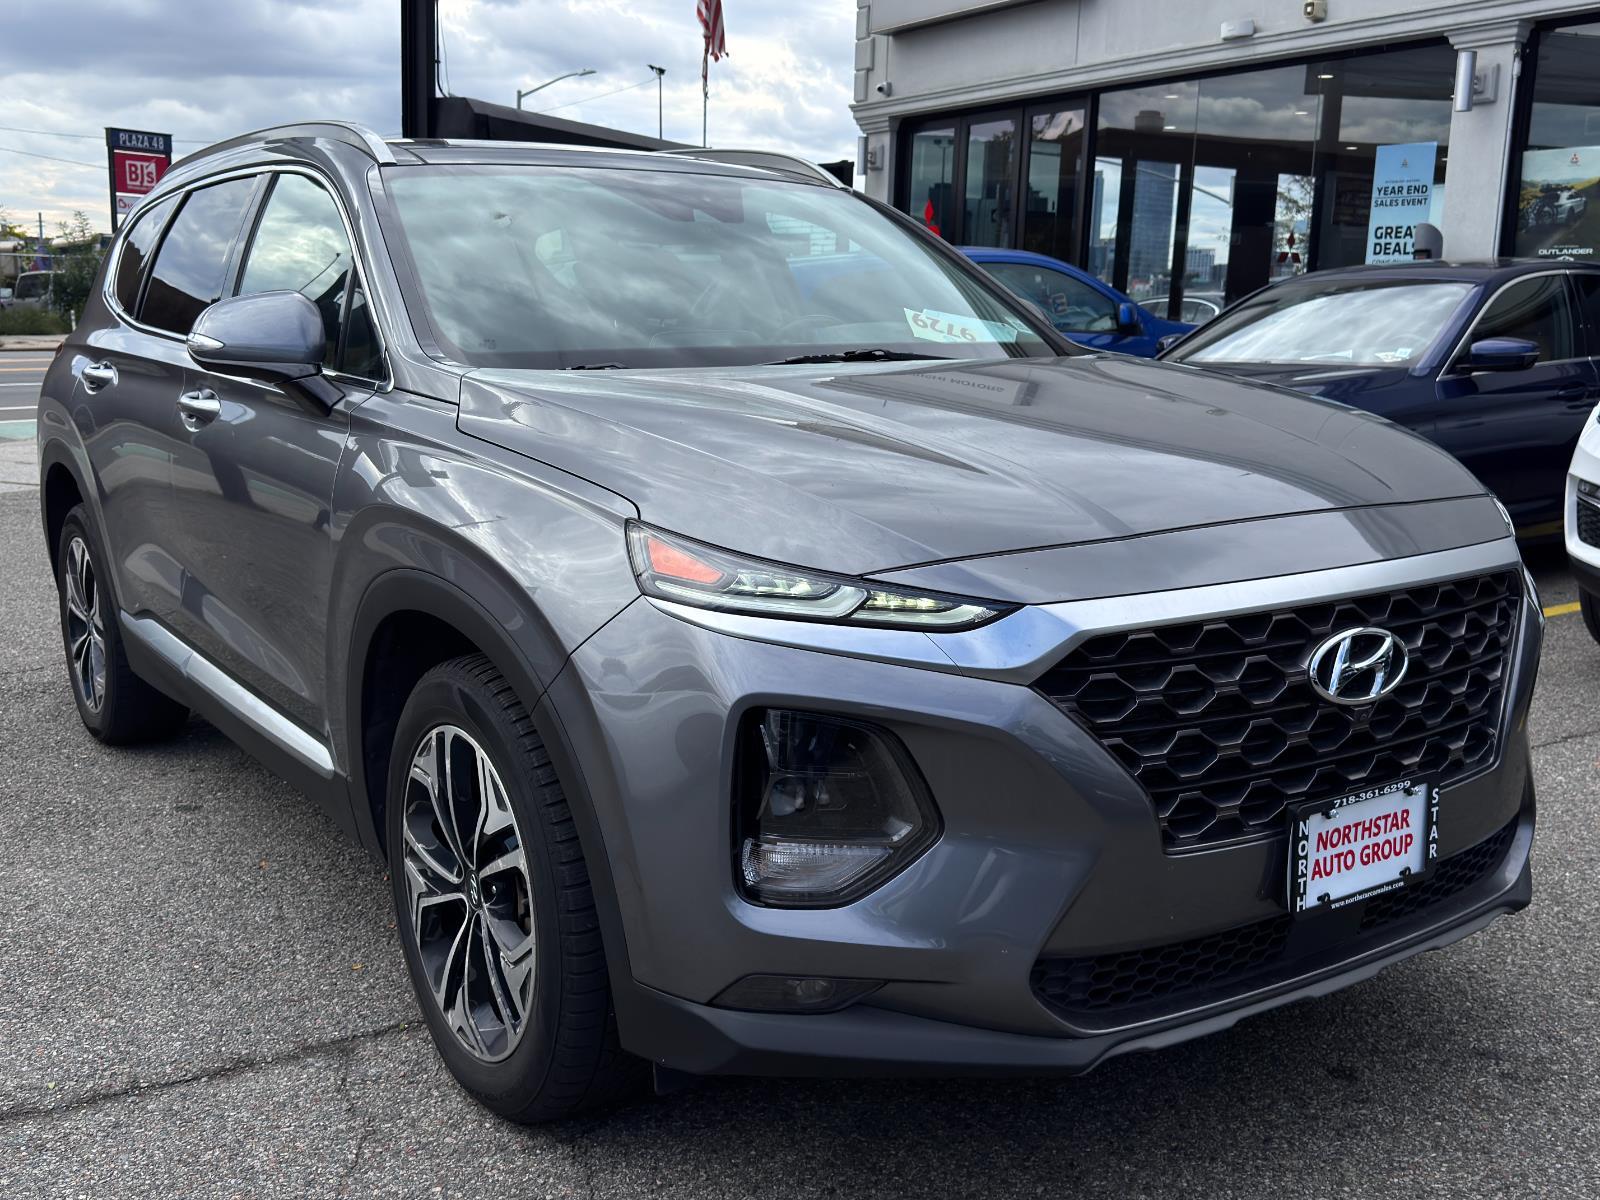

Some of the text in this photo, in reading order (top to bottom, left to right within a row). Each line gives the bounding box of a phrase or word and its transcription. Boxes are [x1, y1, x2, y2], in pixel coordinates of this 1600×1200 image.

[119, 132, 165, 150] PLAZA 48
[1377, 184, 1428, 196] YEAR END
[1374, 197, 1428, 208] SALES EVENT
[1374, 225, 1417, 240] GREA
[1538, 248, 1594, 256] OUTLANDER
[1334, 780, 1411, 808] 718-361-6299
[1316, 808, 1410, 853] NORTHSTAR
[1429, 788, 1439, 859] STAR
[1296, 819, 1309, 913] NORTH
[1310, 833, 1414, 881] AUTO GROUP
